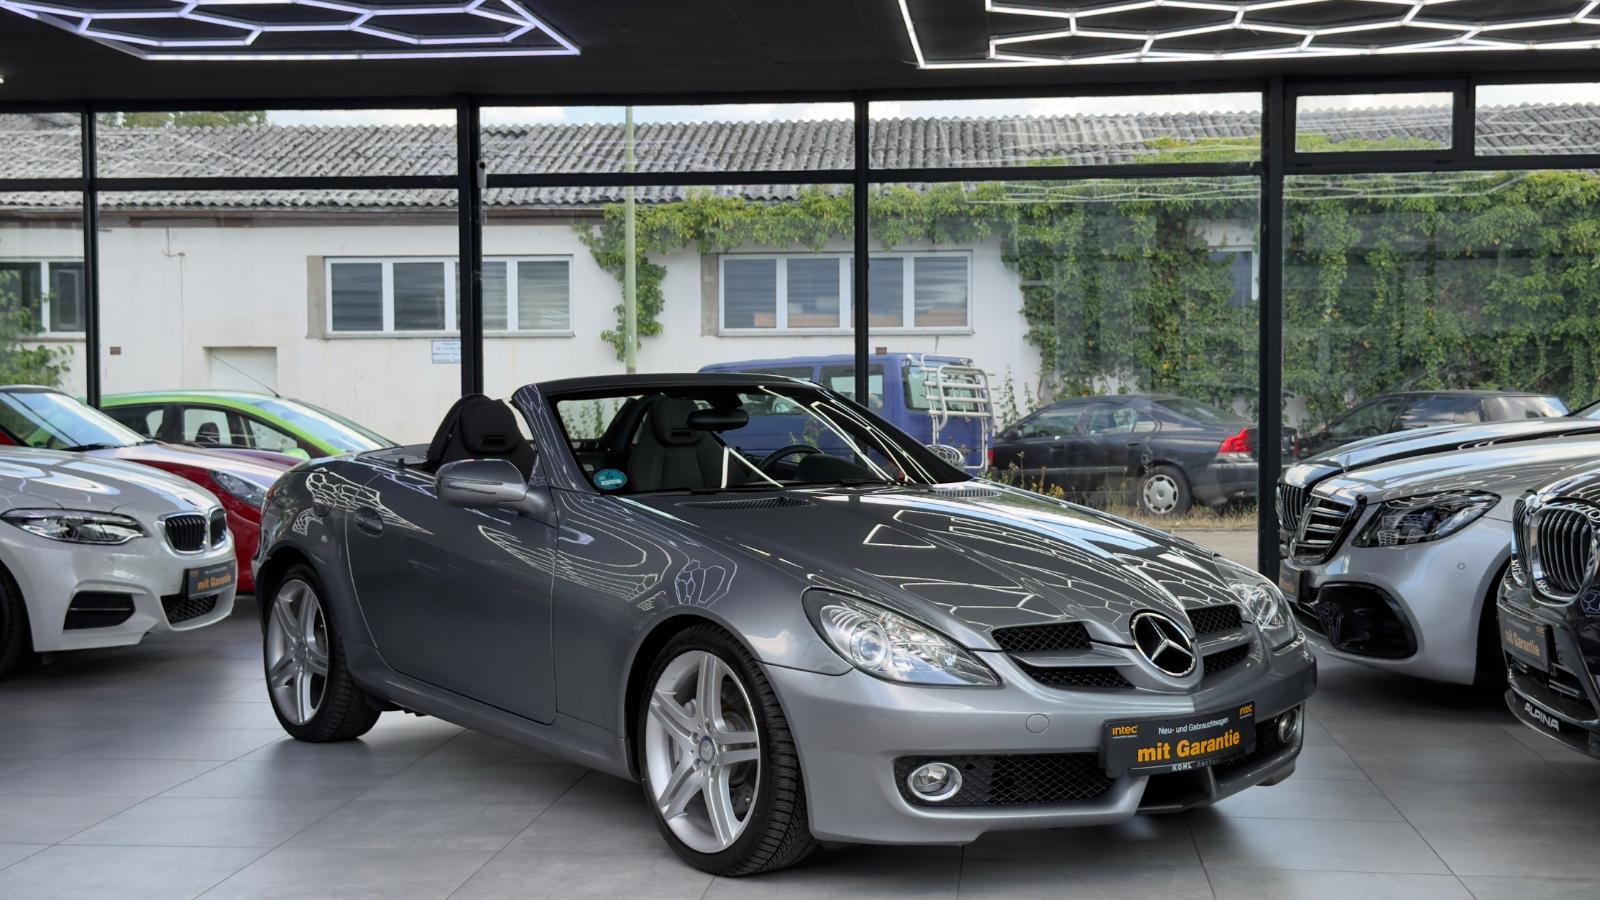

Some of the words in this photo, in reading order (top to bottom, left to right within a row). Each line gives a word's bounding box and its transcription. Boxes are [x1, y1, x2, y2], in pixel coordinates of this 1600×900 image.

[1158, 726, 1175, 735] Neu-
[1175, 724, 1188, 733] und
[1524, 702, 1559, 731] ALPINA
[1137, 742, 1170, 762] mit
[1176, 729, 1240, 758] Garantie
